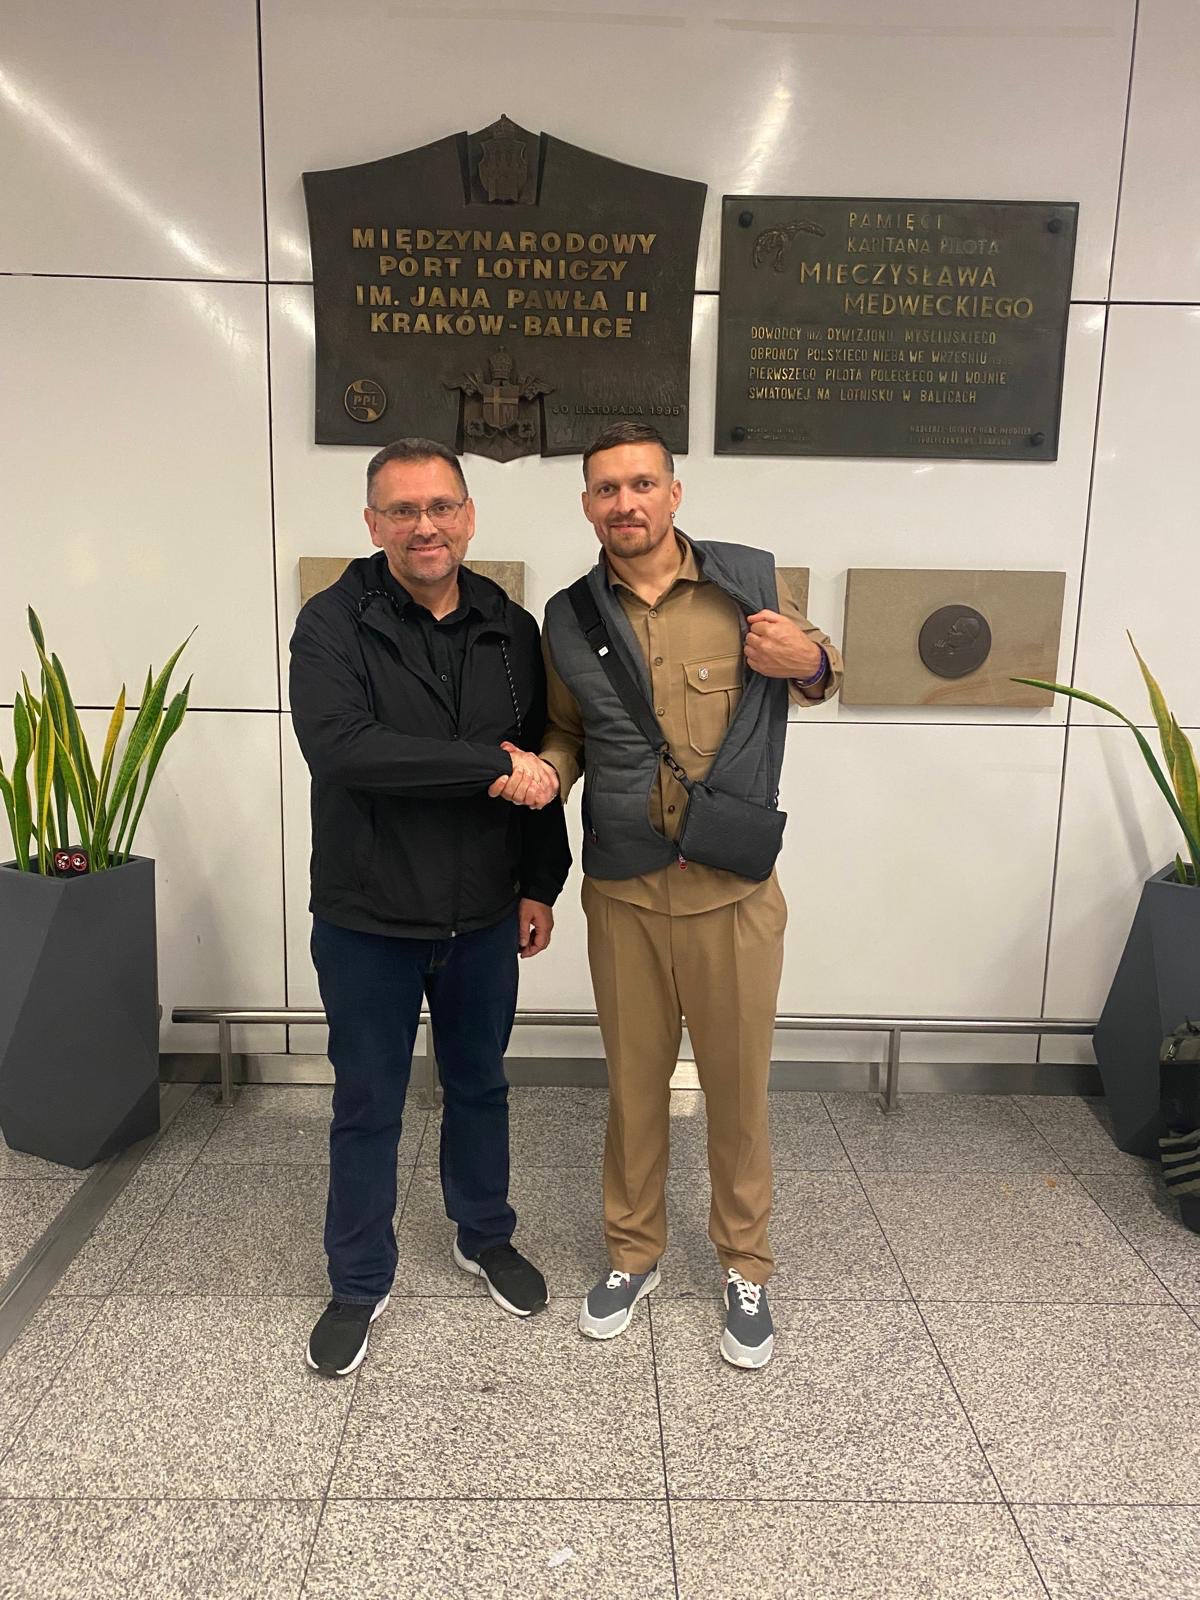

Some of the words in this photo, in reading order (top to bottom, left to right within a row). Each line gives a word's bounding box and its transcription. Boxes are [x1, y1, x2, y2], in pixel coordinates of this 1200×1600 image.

[352, 227, 656, 255] MIĘDZYNARODOWY
[847, 237, 930, 254] KAPITANA
[379, 255, 462, 277] PORT
[477, 256, 628, 281] LOTNICZY
[800, 261, 998, 288] MIECZYSŁAWA
[356, 284, 400, 306] IM.
[410, 286, 491, 308] JANA
[507, 288, 608, 311] PAWŁA
[626, 291, 648, 312] II
[845, 292, 1034, 319] MEDWECKIEGO
[909, 350, 925, 363] WE
[749, 366, 816, 381] PIERWSZEGO
[825, 367, 863, 381] PILOTA
[939, 371, 948, 383] W
[965, 370, 1008, 384] WOJNIE
[353, 395, 378, 406] PPL
[817, 387, 830, 401] NA
[841, 388, 894, 402] LOTNISKU
[903, 389, 911, 402] W
